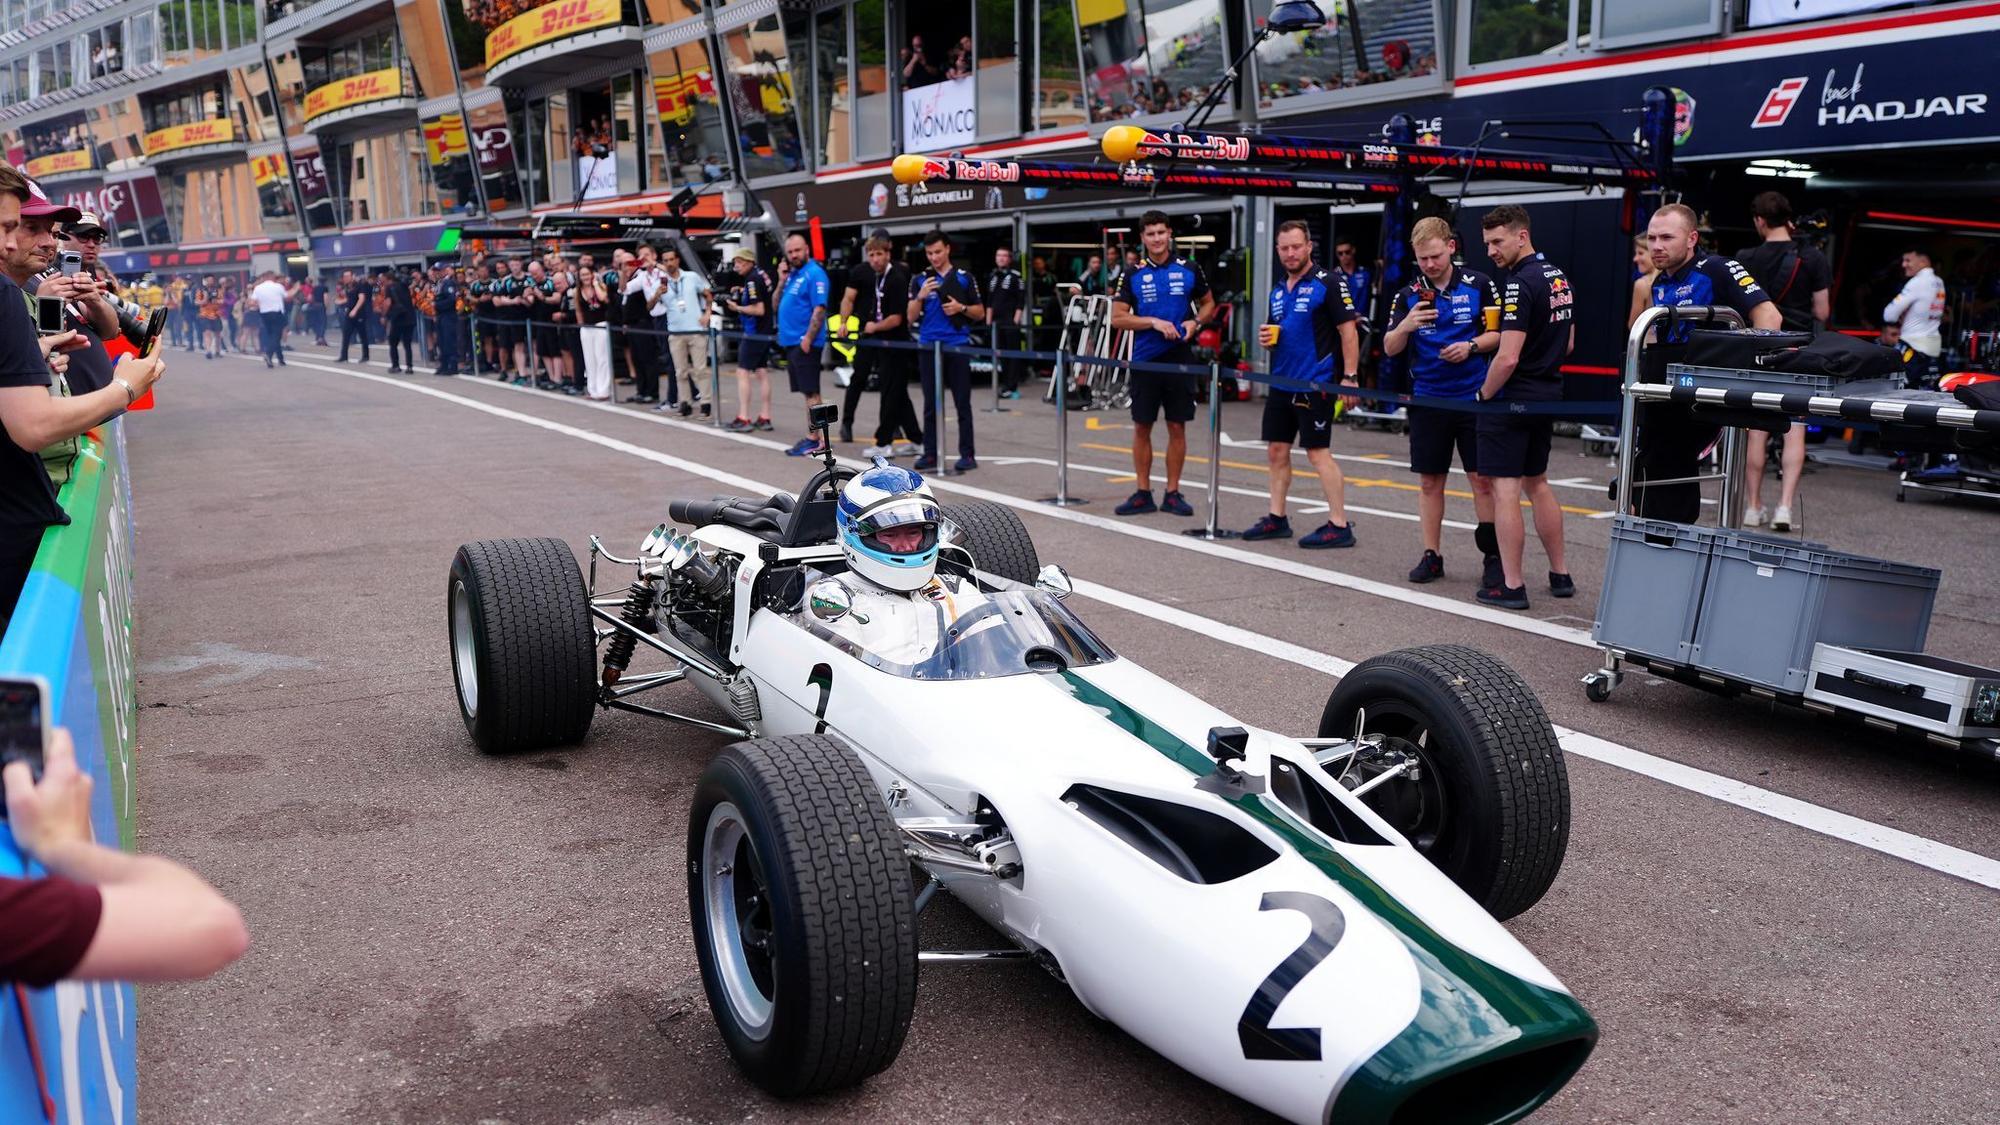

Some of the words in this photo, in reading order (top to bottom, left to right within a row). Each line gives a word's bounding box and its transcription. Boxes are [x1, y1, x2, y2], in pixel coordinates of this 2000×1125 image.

[541, 0, 592, 34] DHL
[344, 76, 381, 99] DHL
[1751, 76, 1809, 129] 6
[1818, 93, 1988, 126] HADJAR
[911, 109, 976, 142] MONACO
[1177, 134, 1214, 158] Red
[1214, 136, 1250, 161] Bull
[955, 160, 989, 179] Red
[989, 162, 1020, 182] Bull
[911, 188, 974, 206] ANTONELLI
[1680, 376, 1694, 387] 16
[1237, 890, 1346, 1062] 2
